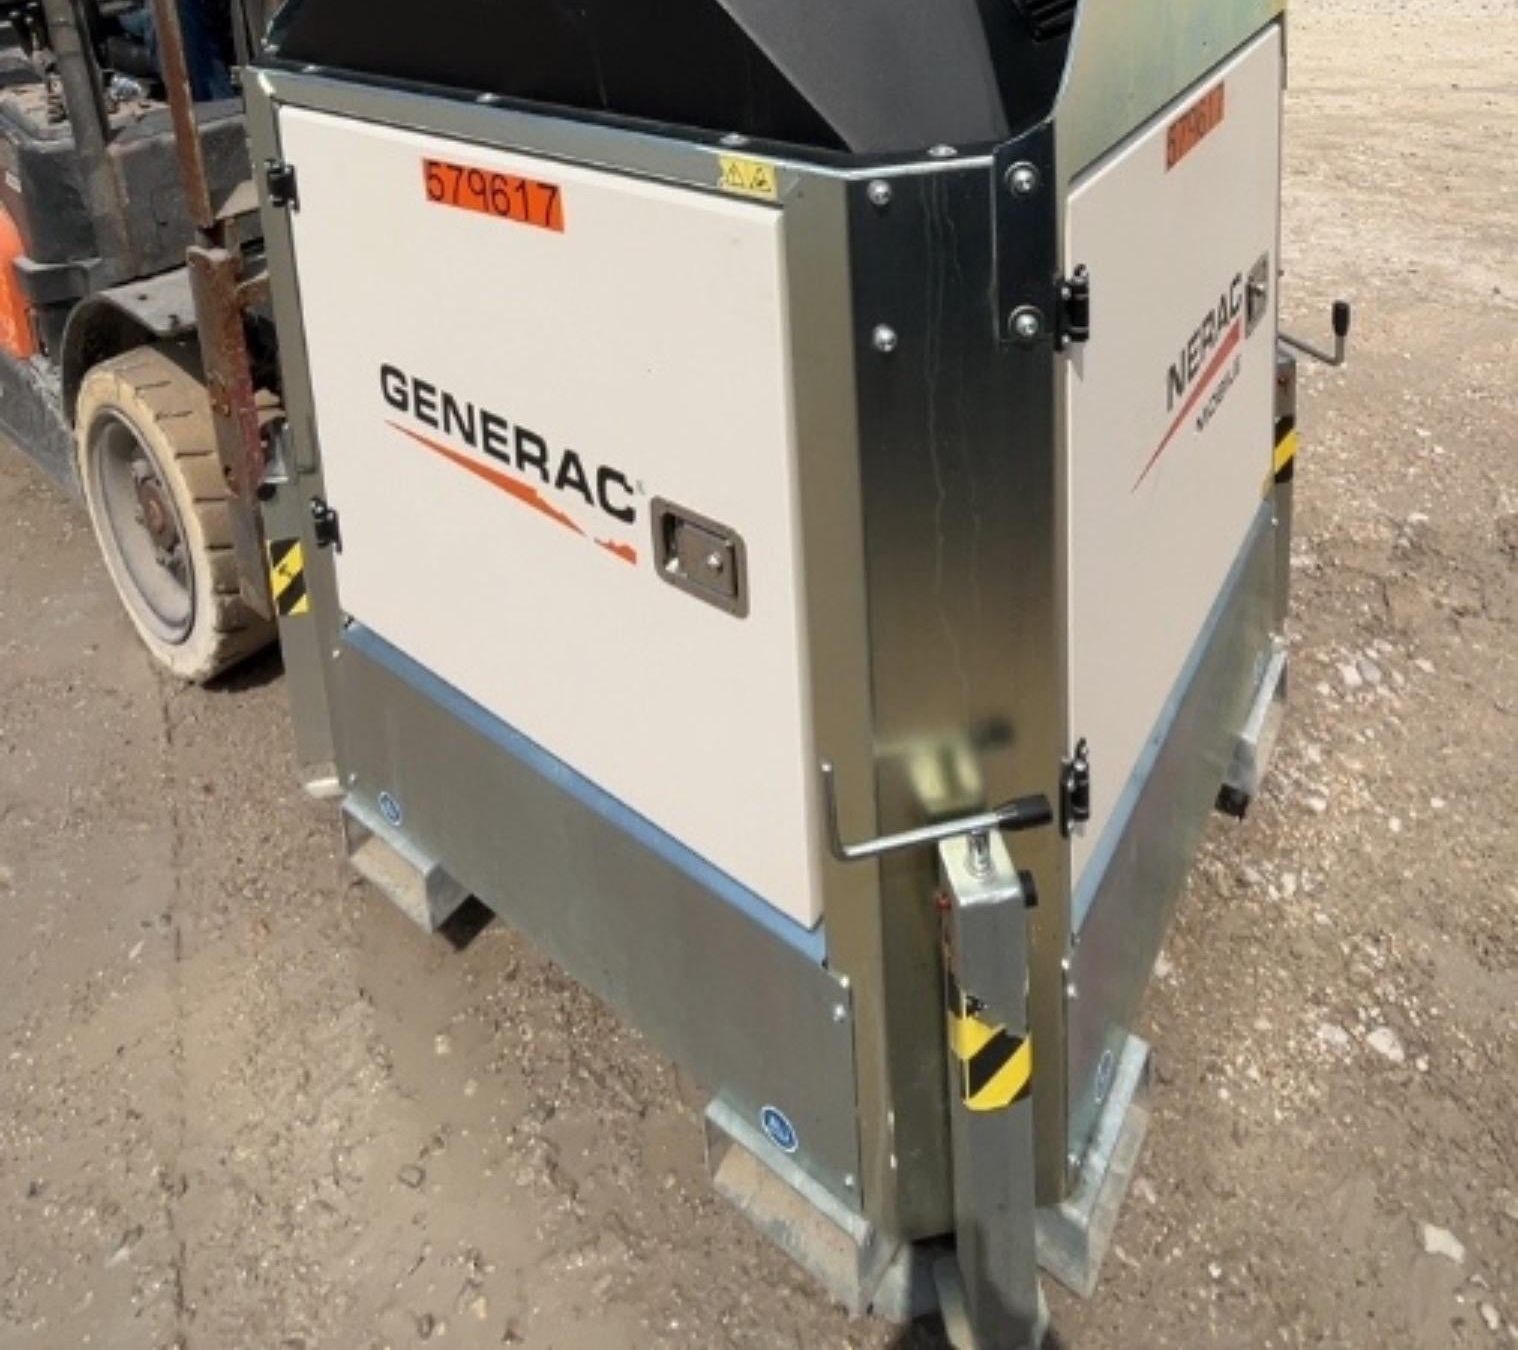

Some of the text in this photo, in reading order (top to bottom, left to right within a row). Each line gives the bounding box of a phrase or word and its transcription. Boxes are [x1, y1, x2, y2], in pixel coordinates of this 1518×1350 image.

[426, 161, 559, 227] 579617
[1166, 271, 1242, 413] NERAC
[379, 362, 637, 524] GENERAC
